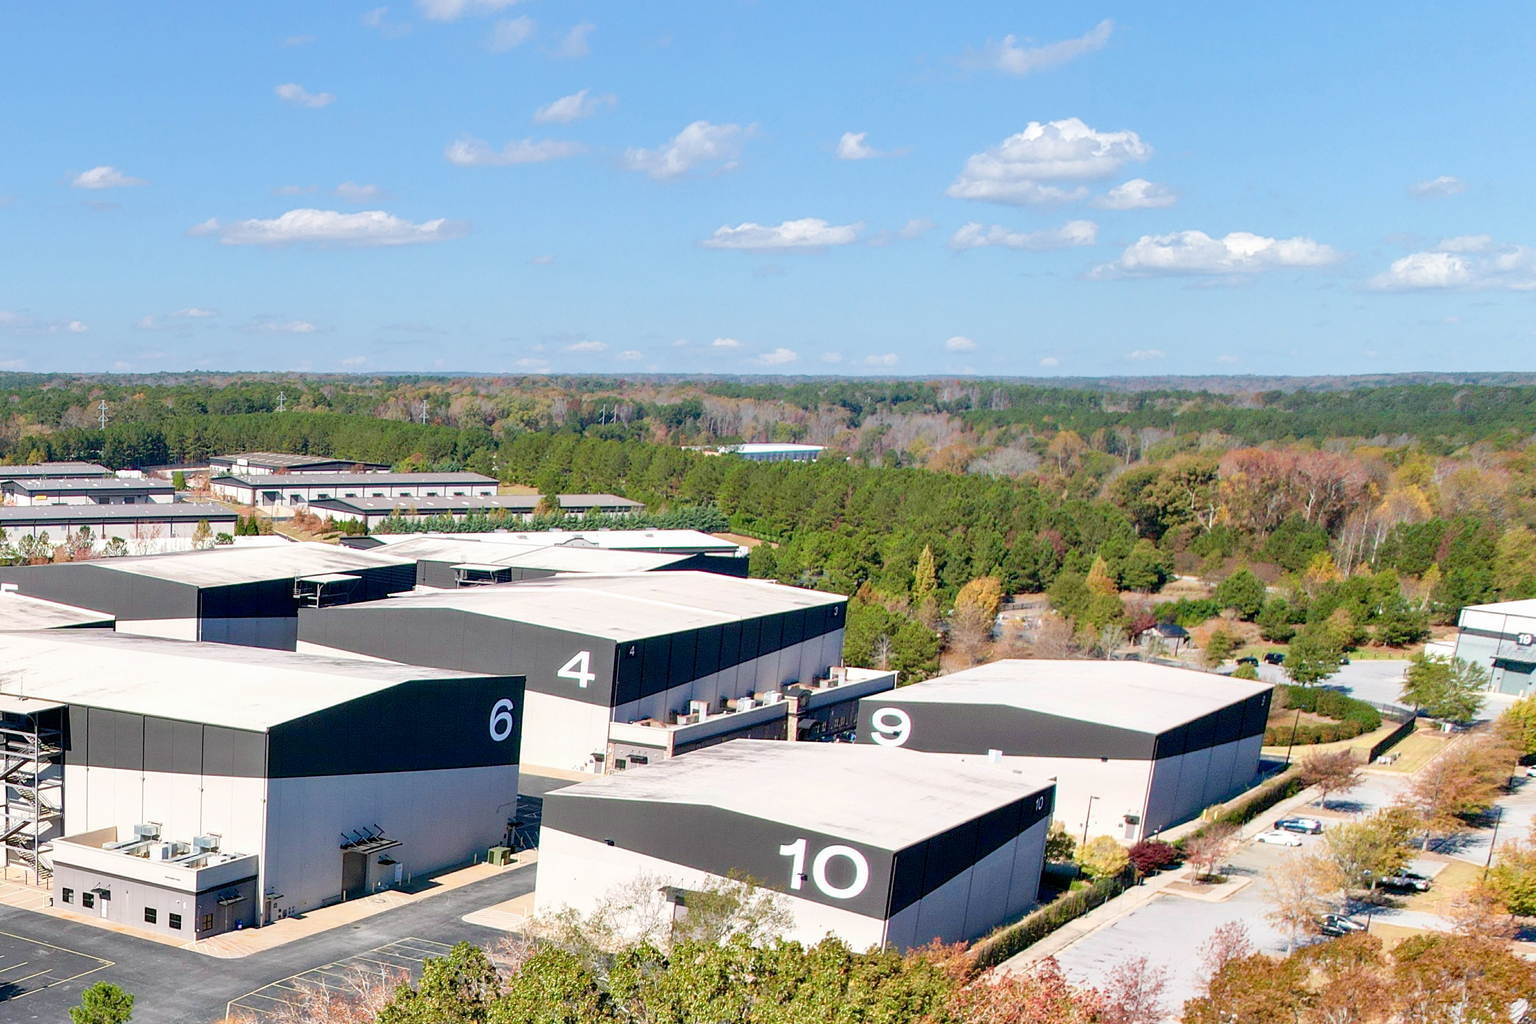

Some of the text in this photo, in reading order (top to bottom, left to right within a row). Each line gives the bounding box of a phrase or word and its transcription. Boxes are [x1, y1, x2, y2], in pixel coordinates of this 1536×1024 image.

[629, 645, 635, 656] 4
[1518, 634, 1532, 645] 19
[557, 650, 596, 689] 4
[489, 698, 514, 742] 6
[871, 707, 912, 747] 9
[779, 838, 870, 899] 10
